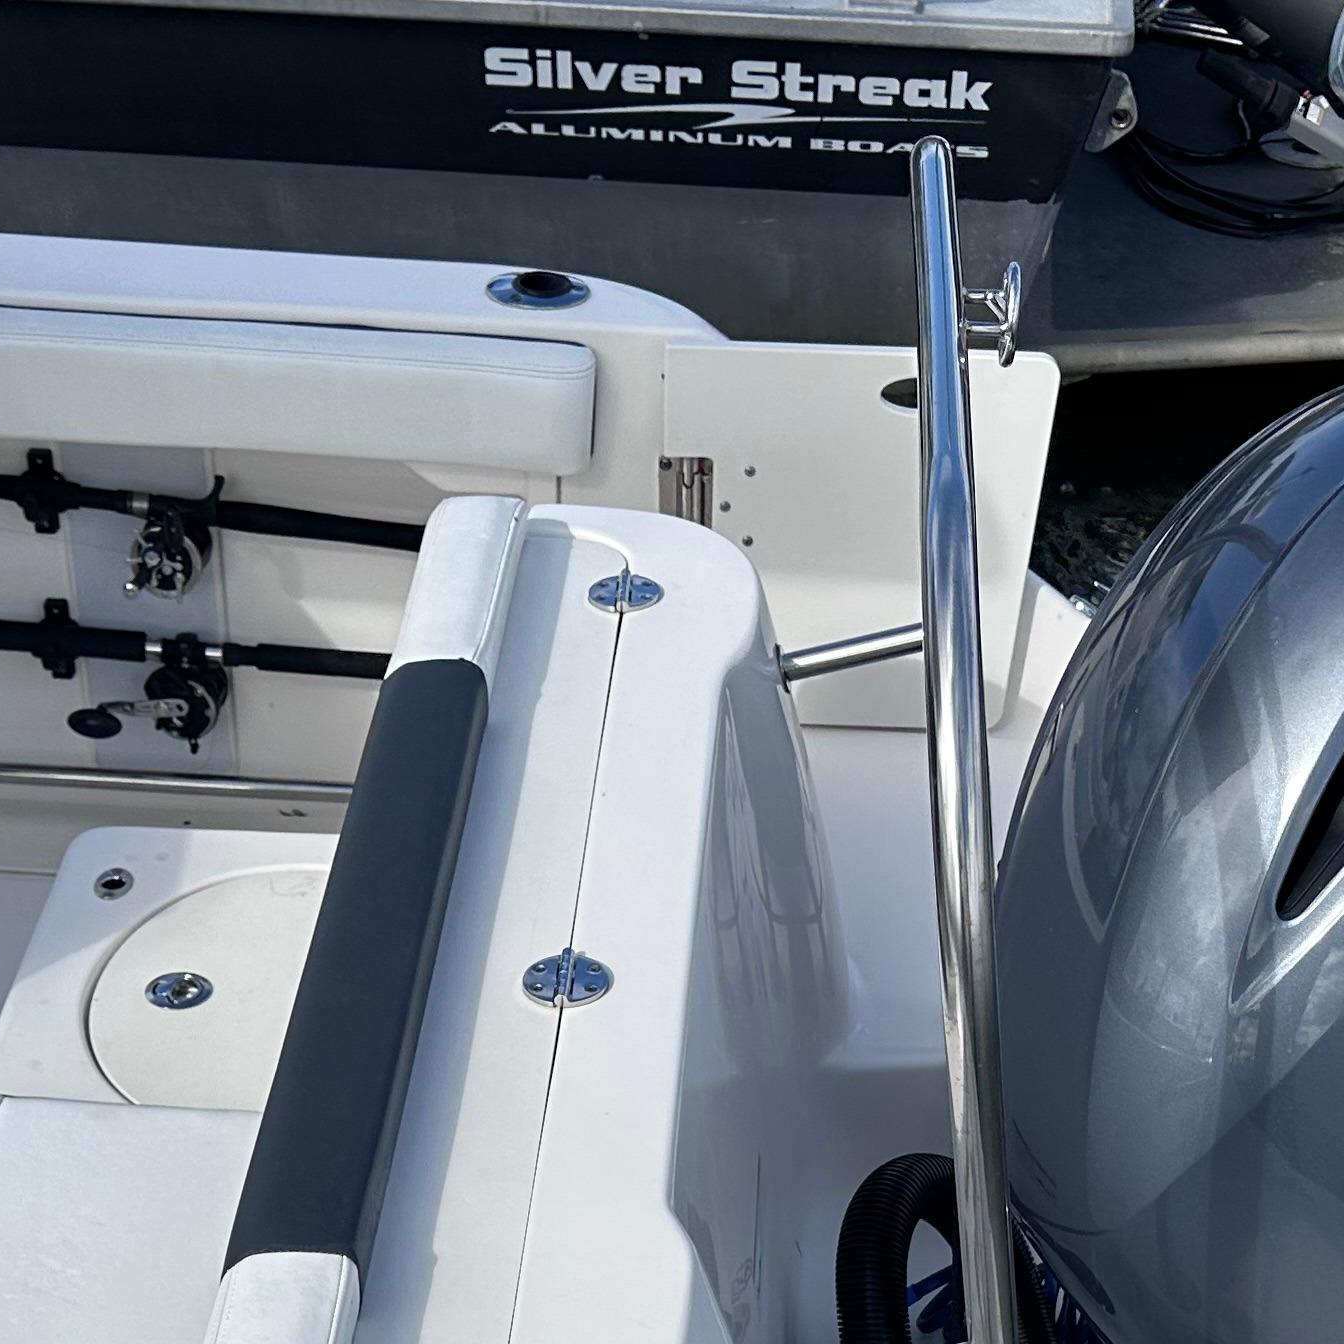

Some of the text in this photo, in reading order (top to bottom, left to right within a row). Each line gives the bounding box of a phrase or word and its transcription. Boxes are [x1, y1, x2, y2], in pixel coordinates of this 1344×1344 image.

[484, 46, 993, 111] Silver Streak
[488, 121, 989, 158] ALUMINUM BOAS
